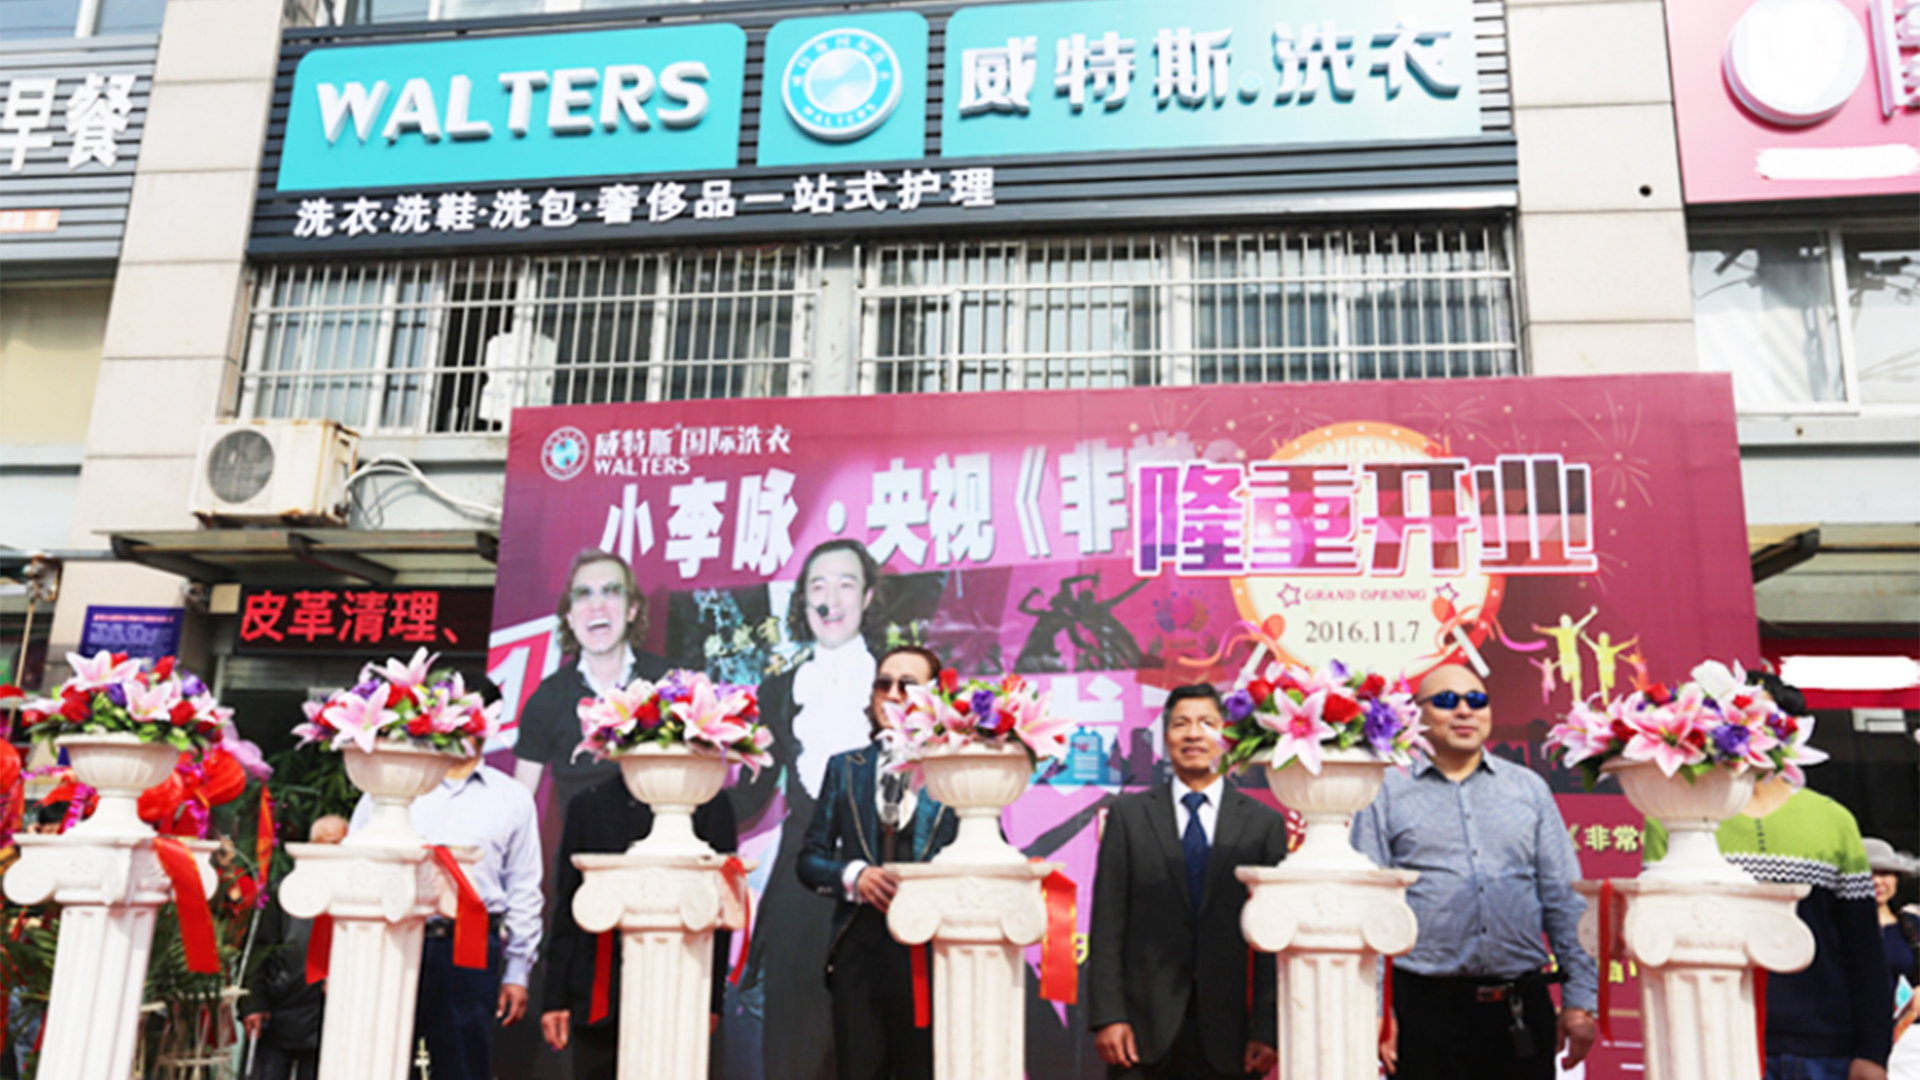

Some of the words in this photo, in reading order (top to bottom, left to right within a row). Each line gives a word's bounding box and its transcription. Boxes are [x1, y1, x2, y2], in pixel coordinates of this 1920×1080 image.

[0, 73, 136, 173] 早餐
[316, 62, 710, 146] WALTERS
[594, 456, 691, 476] WALTERS
[1136, 455, 1598, 576] 隆重开业
[1304, 589, 1356, 600] GRAND
[1360, 589, 1427, 600] OPENING
[1305, 620, 1420, 643] 2016.11.7
